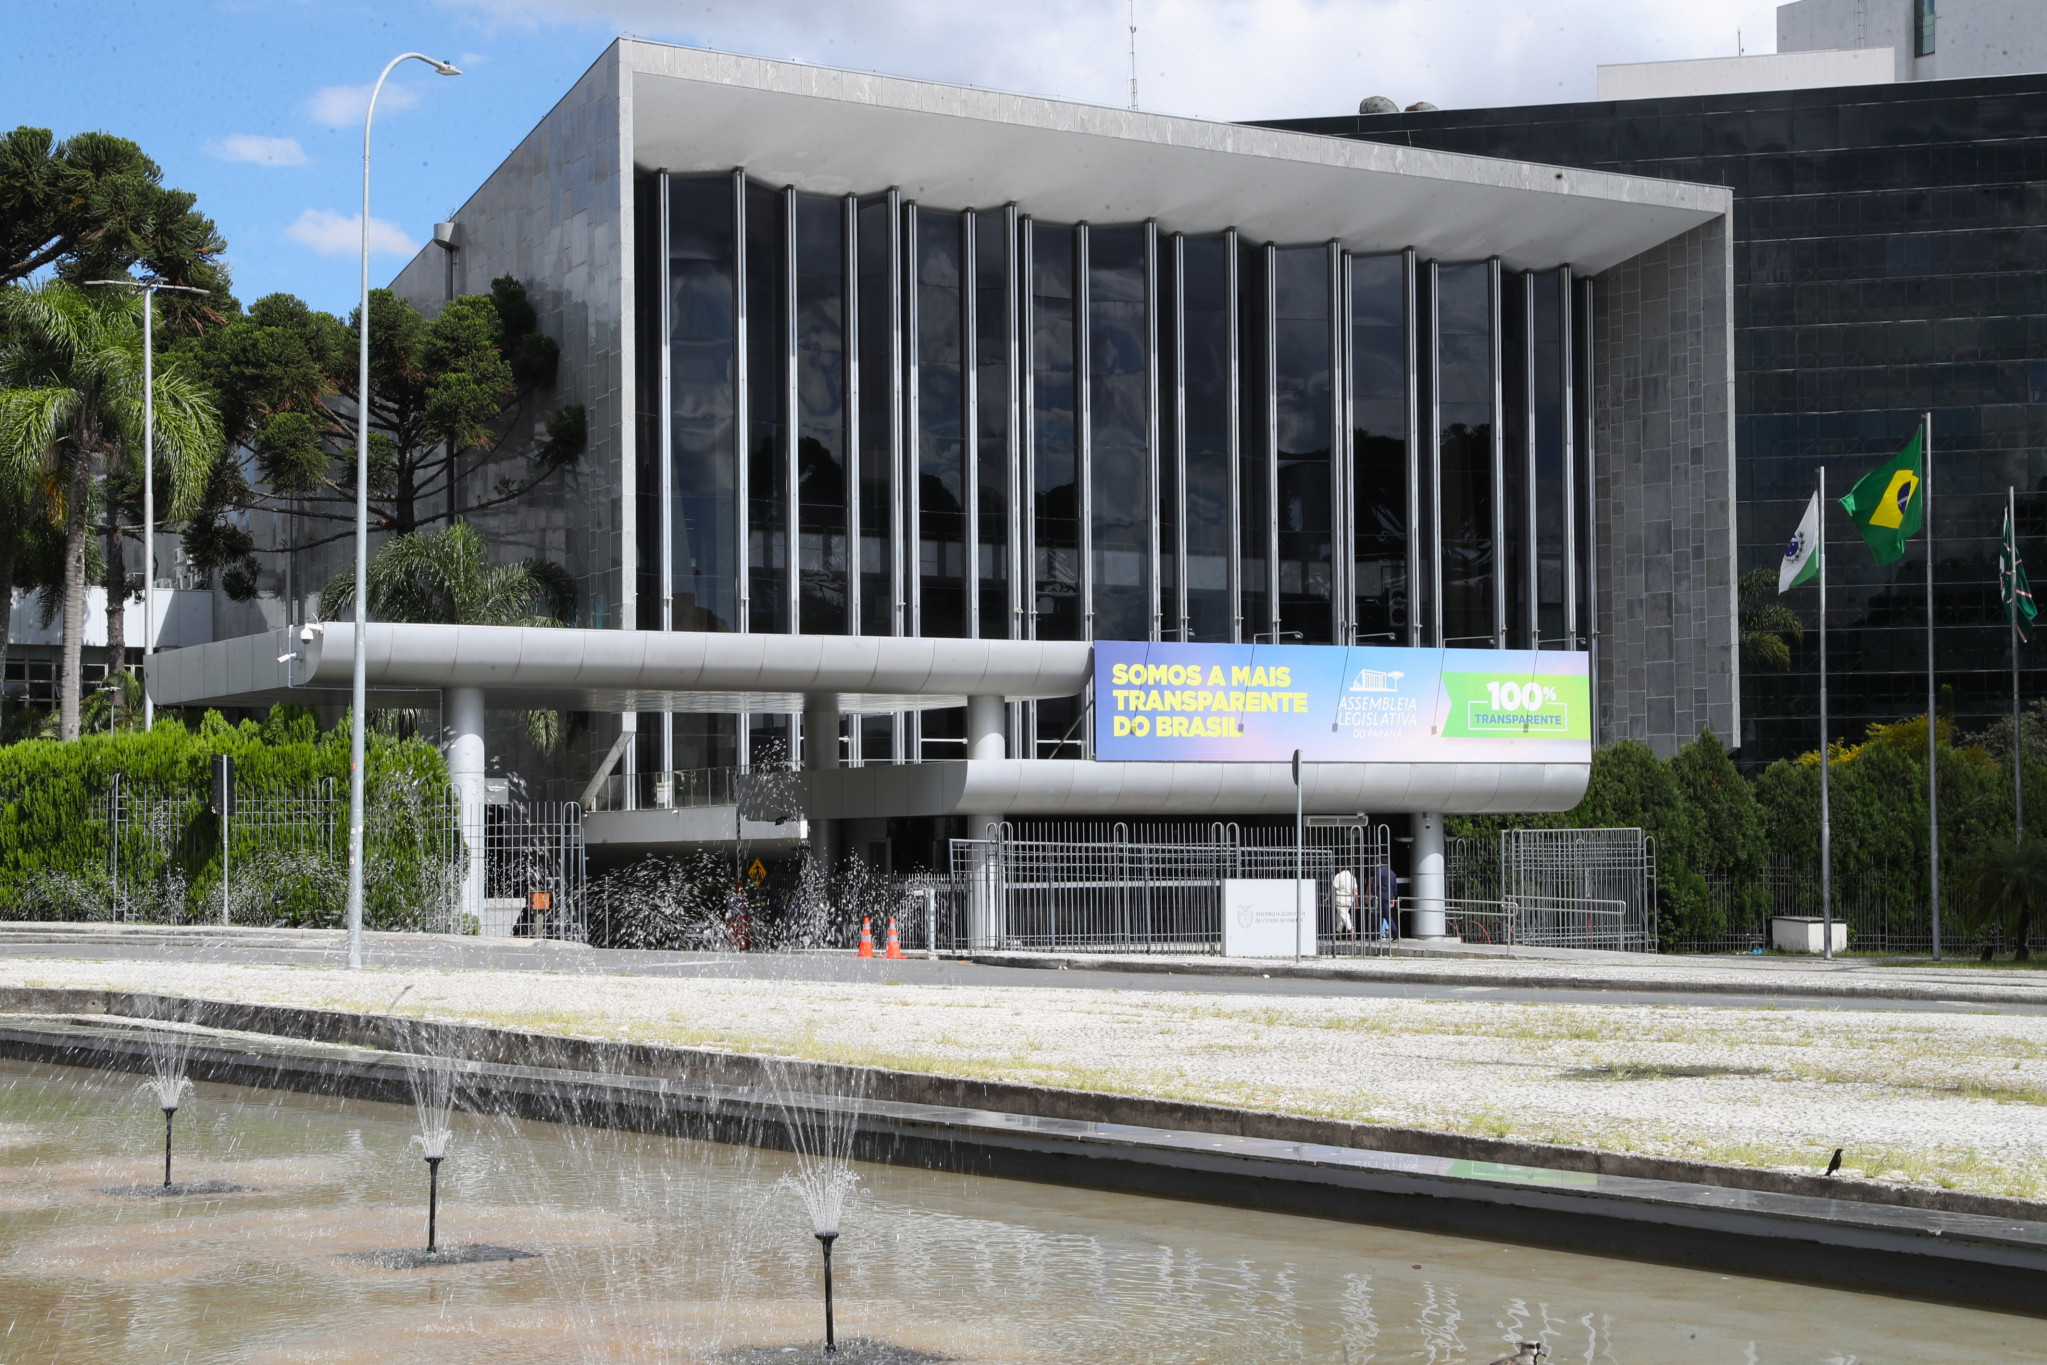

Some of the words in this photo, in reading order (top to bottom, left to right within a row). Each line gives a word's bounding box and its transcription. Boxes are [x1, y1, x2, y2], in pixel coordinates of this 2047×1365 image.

[1112, 663, 1202, 686] SOMOS
[1208, 665, 1226, 686] A
[1232, 666, 1291, 687] MAIS
[1112, 690, 1308, 712] TRANSPARENTE
[1338, 696, 1416, 711] ASSEMBLEIA
[1486, 681, 1557, 711] 100%
[1113, 715, 1150, 737] DO
[1156, 716, 1243, 738] BRASIL
[1338, 711, 1417, 726] LEGISLATIVA
[1475, 714, 1562, 725] TRANSPARENTE
[1353, 728, 1366, 738] DO
[1368, 727, 1402, 738] PARANÁ
